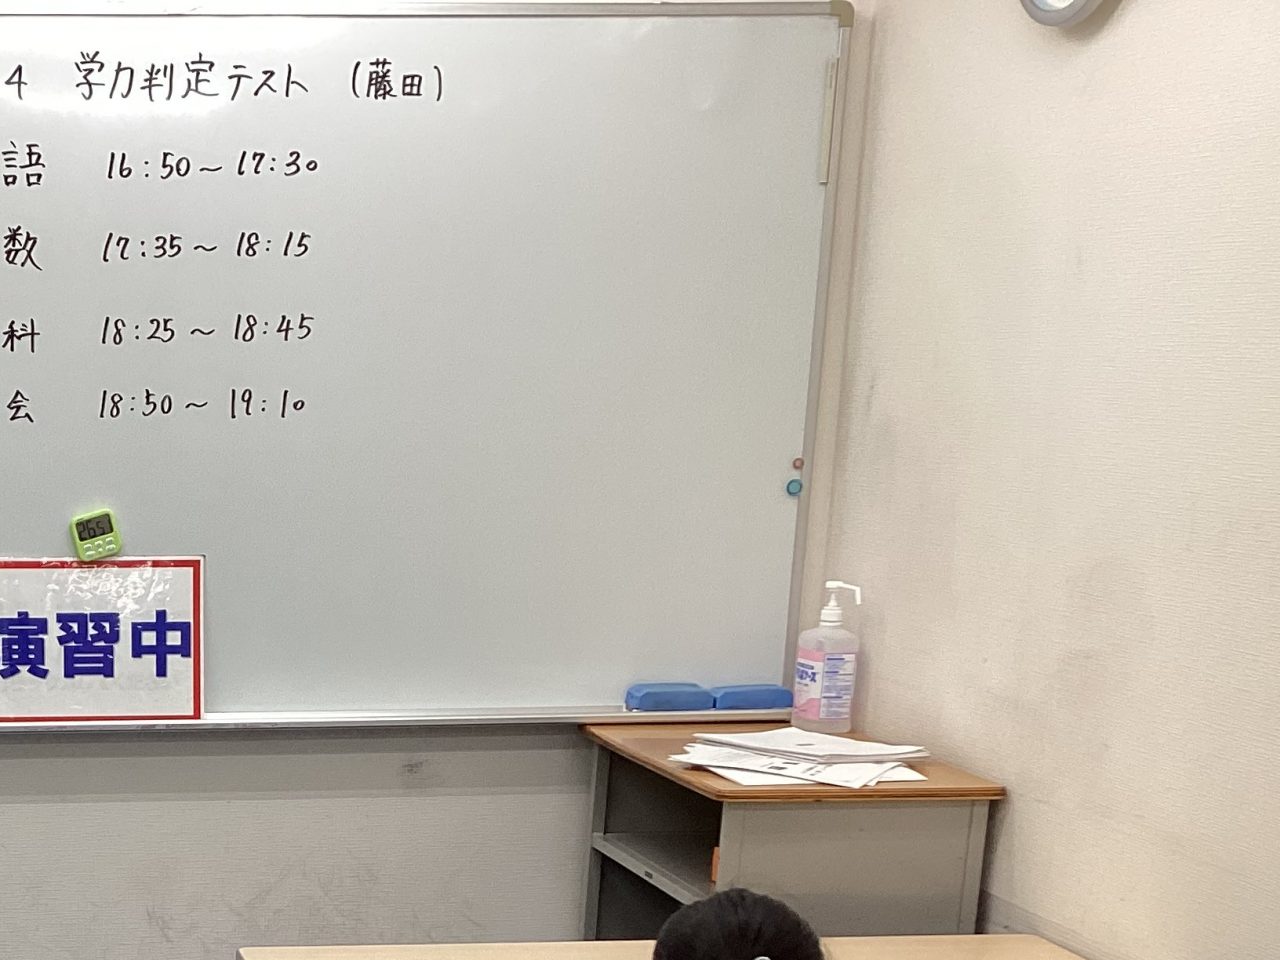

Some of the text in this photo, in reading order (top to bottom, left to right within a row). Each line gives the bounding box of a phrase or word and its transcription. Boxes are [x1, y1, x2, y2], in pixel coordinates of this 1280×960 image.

[73, 50, 309, 103] 学力判定テスト
[351, 57, 443, 102] (藤田)
